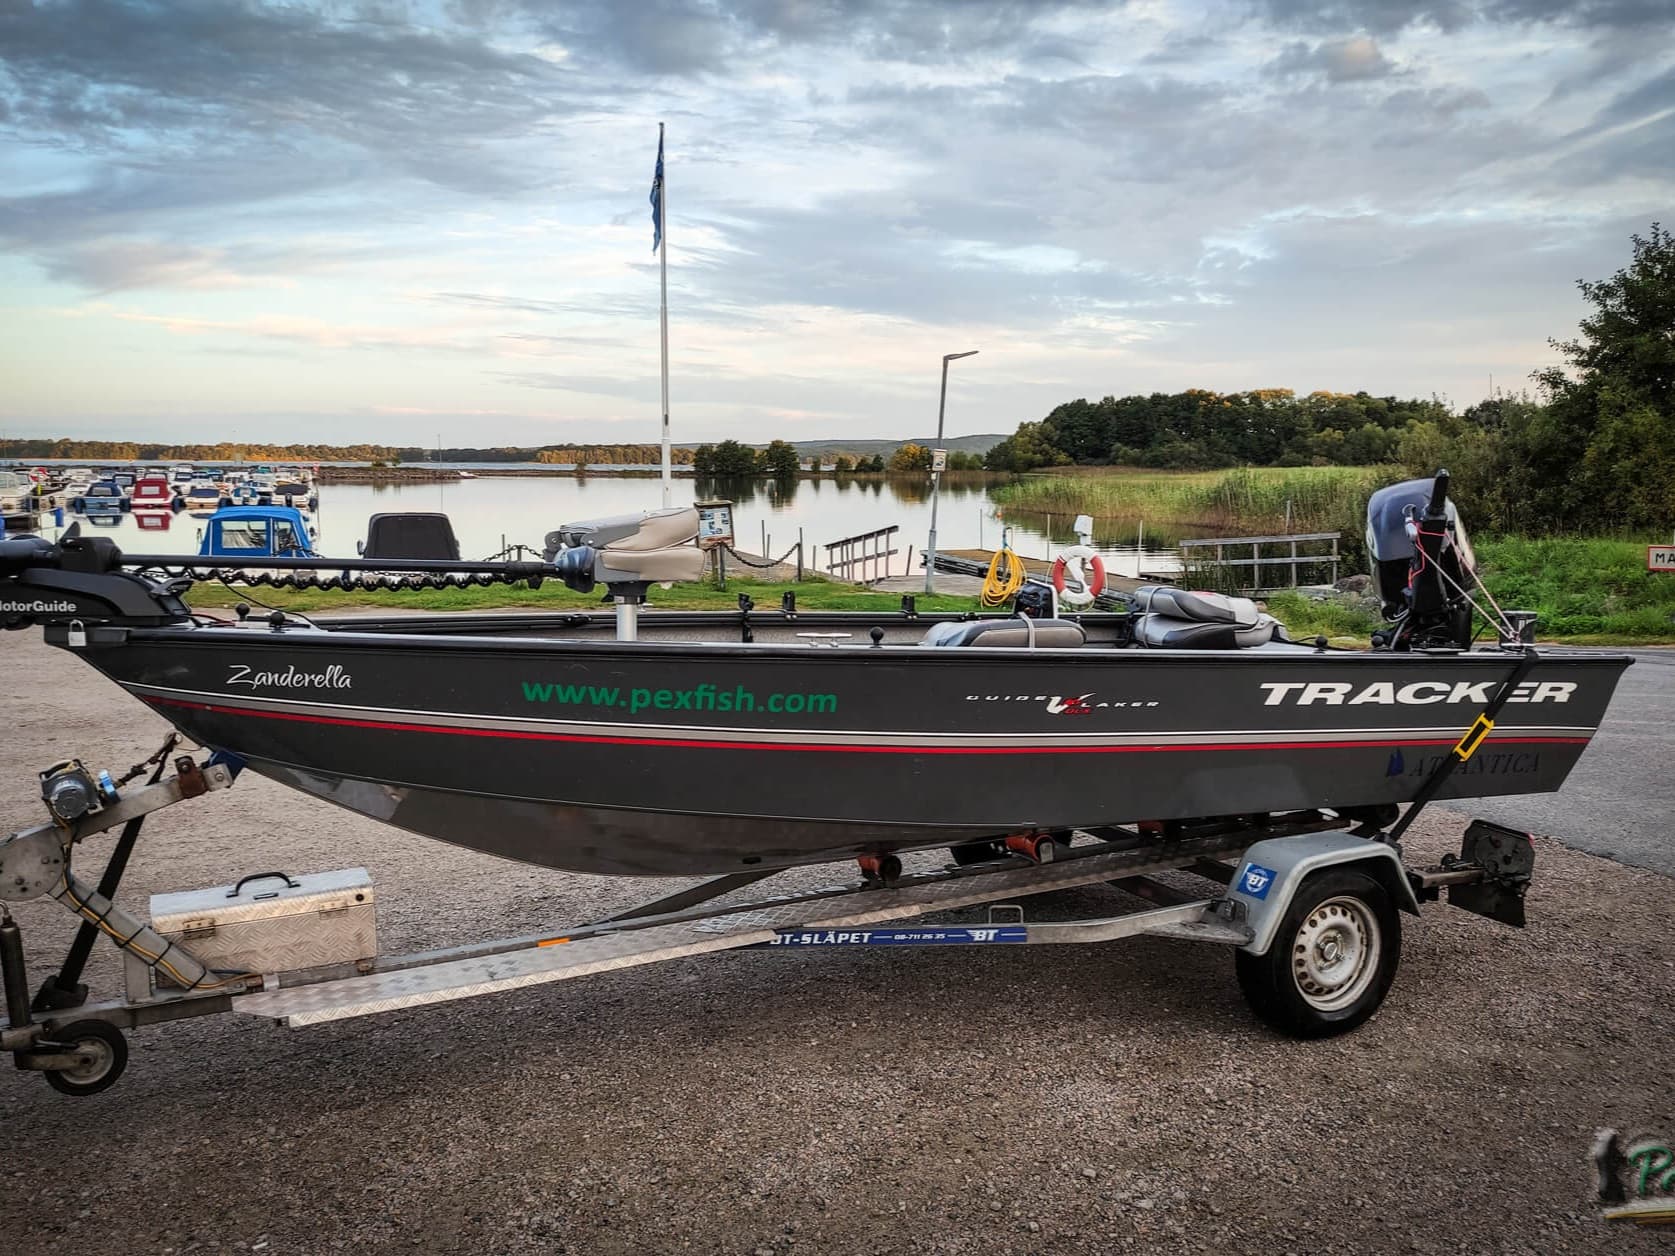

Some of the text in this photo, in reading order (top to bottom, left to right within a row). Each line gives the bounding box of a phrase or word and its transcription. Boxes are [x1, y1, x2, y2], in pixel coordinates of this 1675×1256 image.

[0, 600, 77, 612] otorGuide
[226, 664, 352, 690] Zanderella
[522, 681, 837, 714] www.pexfish.com
[1259, 681, 1578, 705] TRACKER
[1408, 752, 1541, 777] ATANTICA
[1247, 871, 1269, 887] BT
[966, 929, 999, 941] BT
